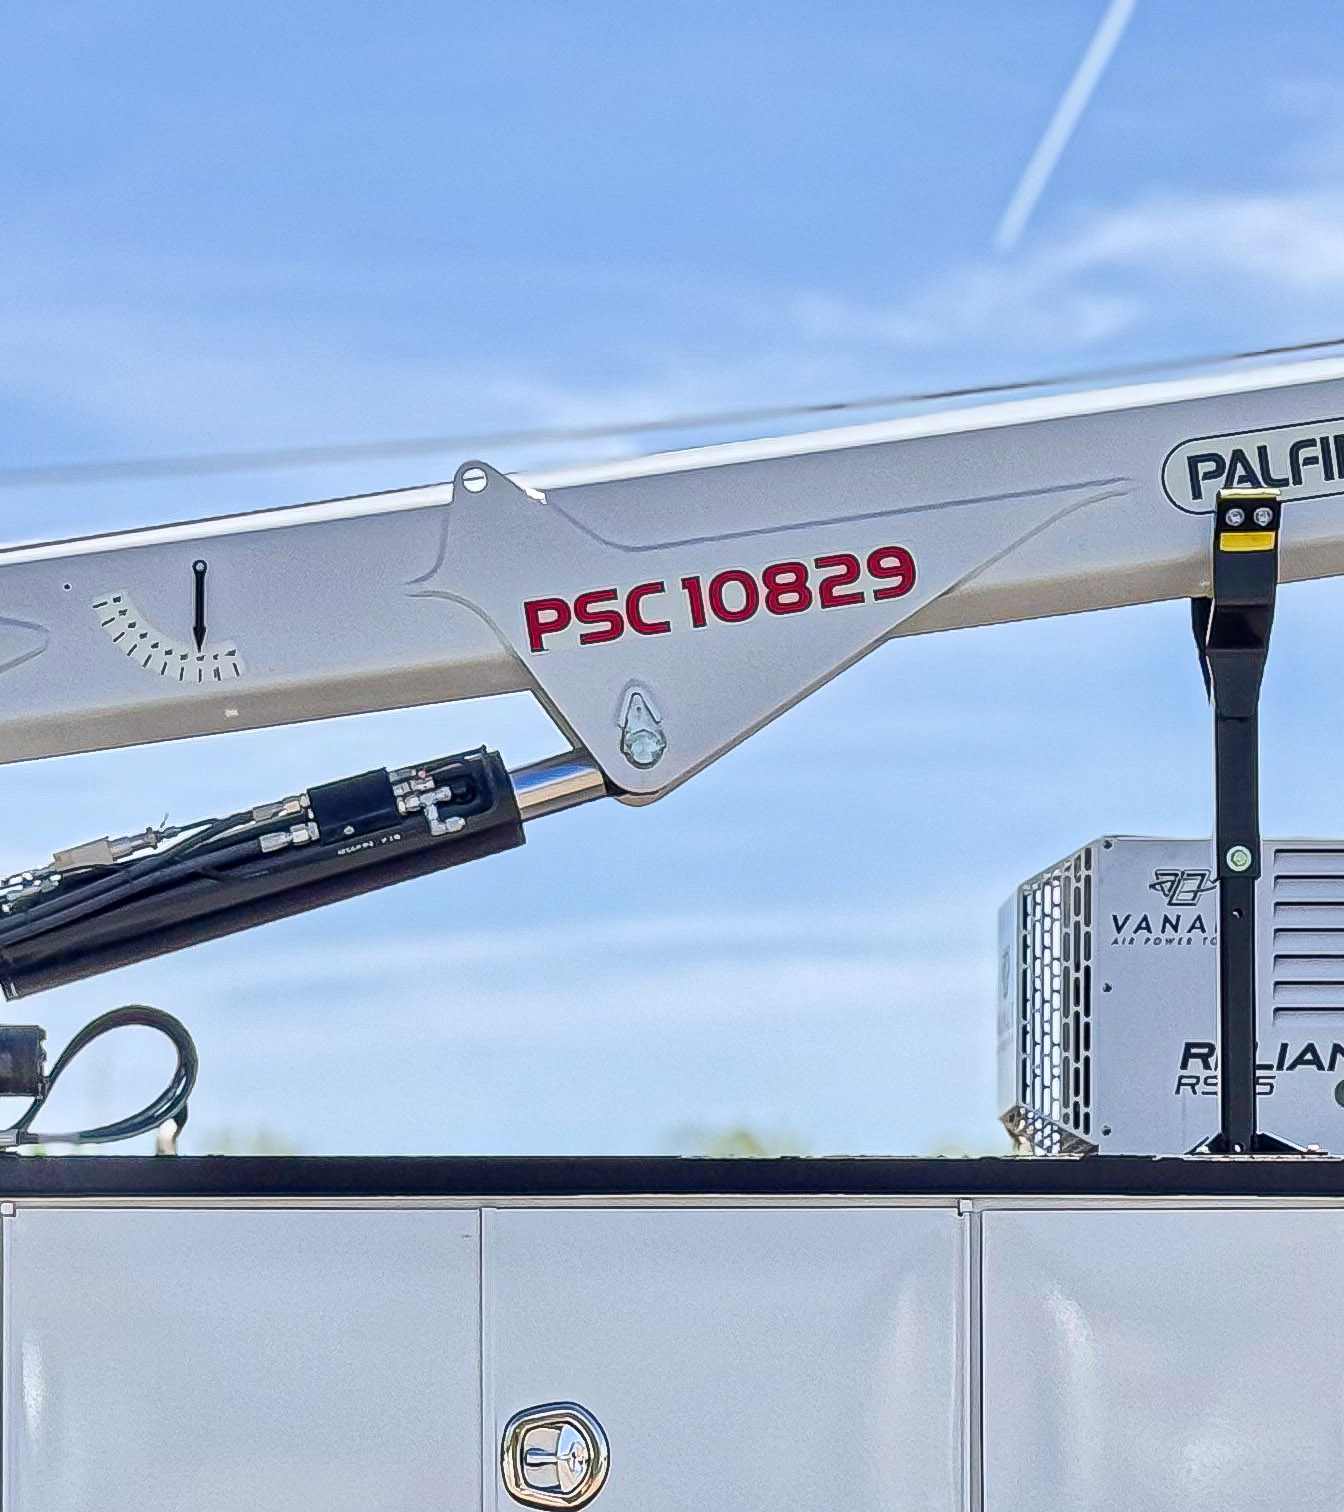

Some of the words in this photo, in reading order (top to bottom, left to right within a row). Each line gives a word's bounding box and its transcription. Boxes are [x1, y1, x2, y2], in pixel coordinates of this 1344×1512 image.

[523, 579, 672, 654] PSC
[681, 545, 917, 629] 10829
[1111, 913, 1218, 935] VANA
[1111, 937, 1135, 946] AIR
[1144, 937, 1193, 946] POWER
[1175, 1075, 1277, 1096] RS5
